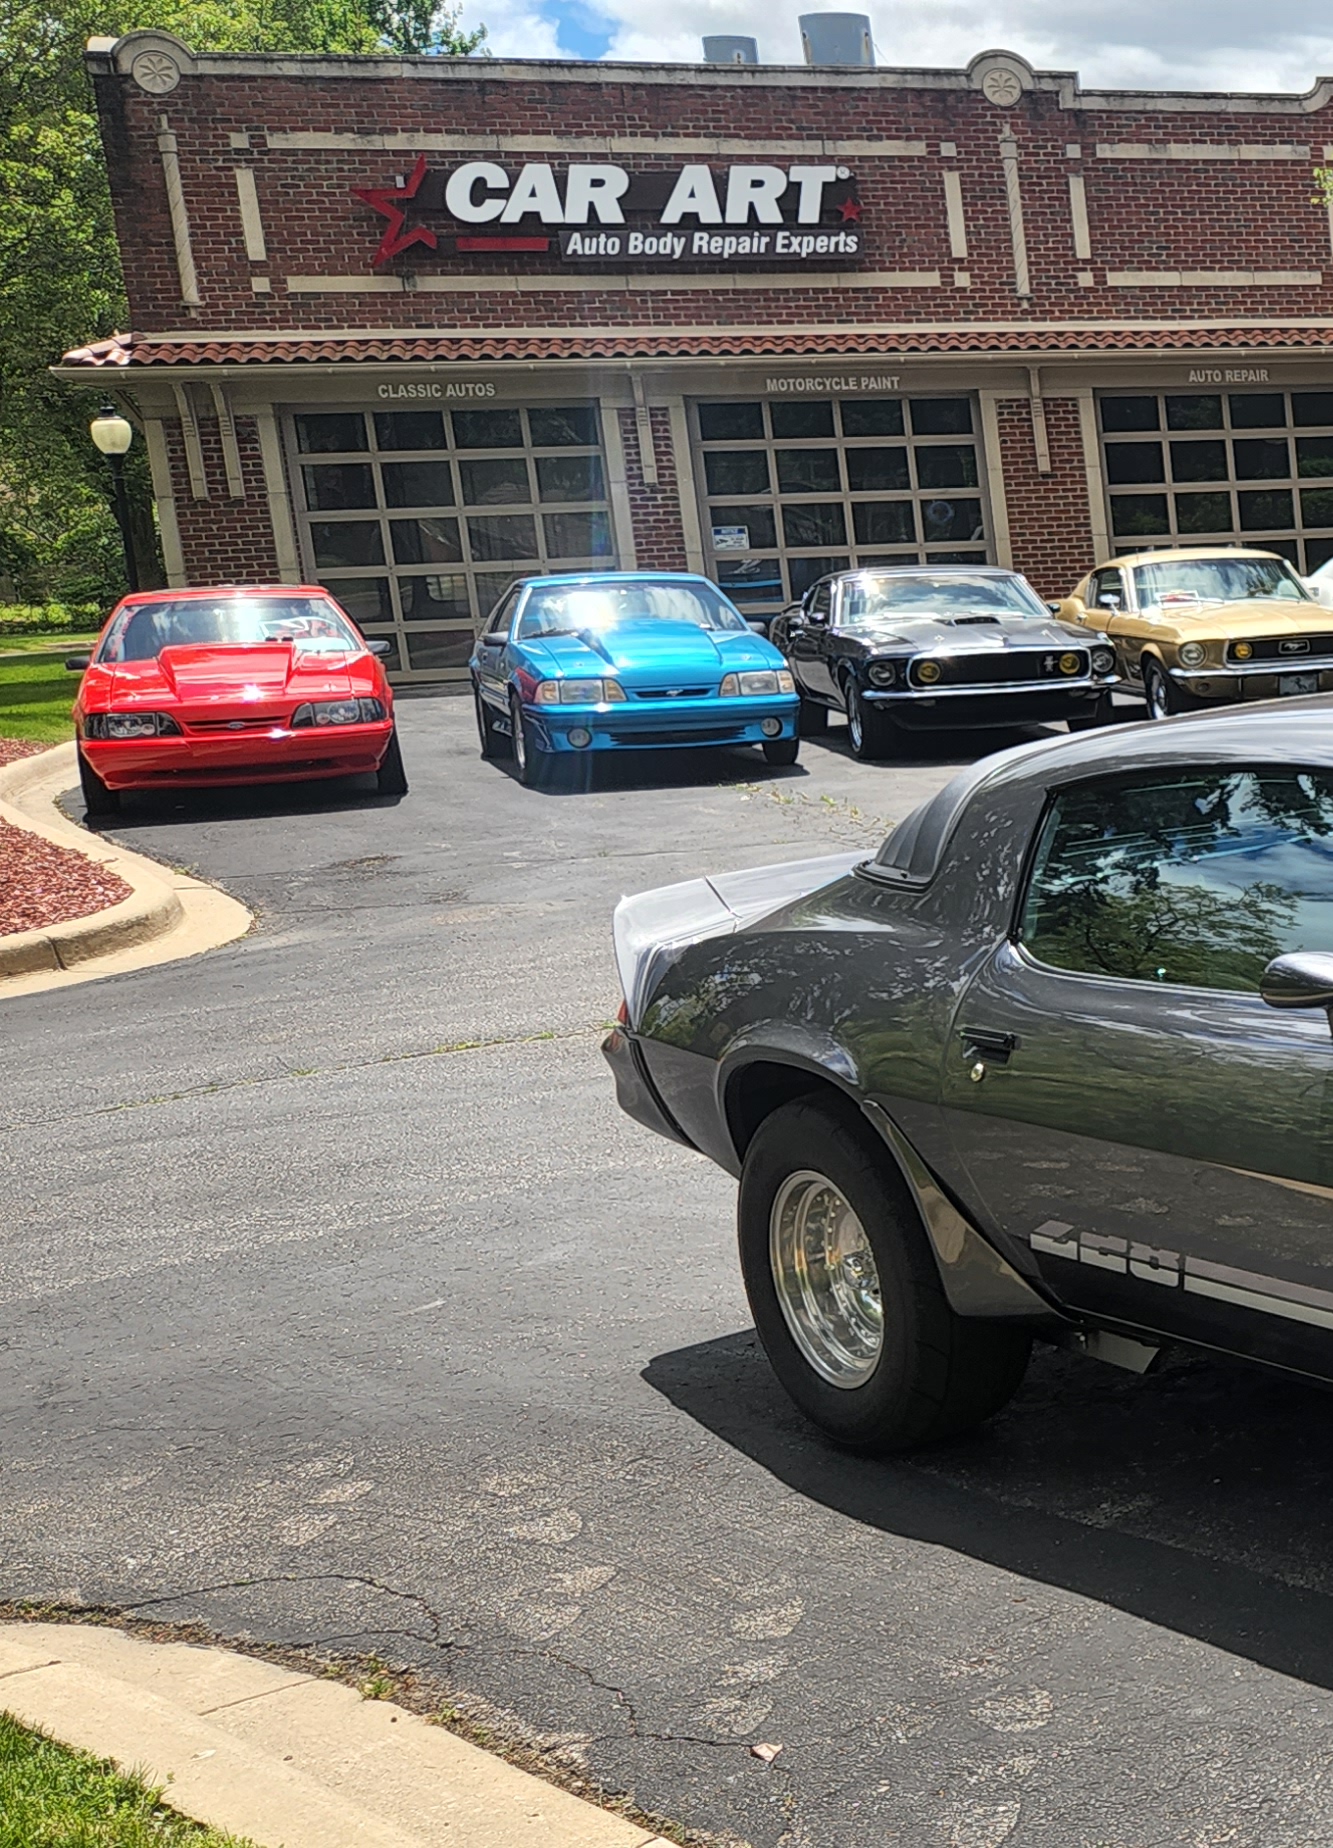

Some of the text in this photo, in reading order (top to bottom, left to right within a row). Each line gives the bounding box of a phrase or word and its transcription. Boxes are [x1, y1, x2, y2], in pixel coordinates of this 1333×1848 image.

[445, 162, 630, 224] CAR
[566, 231, 858, 259] Auto Body Repair Experts
[766, 376, 900, 392] MOTORCYCLE PAINT
[1188, 369, 1269, 383] AUTO REPAIR
[378, 383, 495, 398] CLASSIC AUTOS
